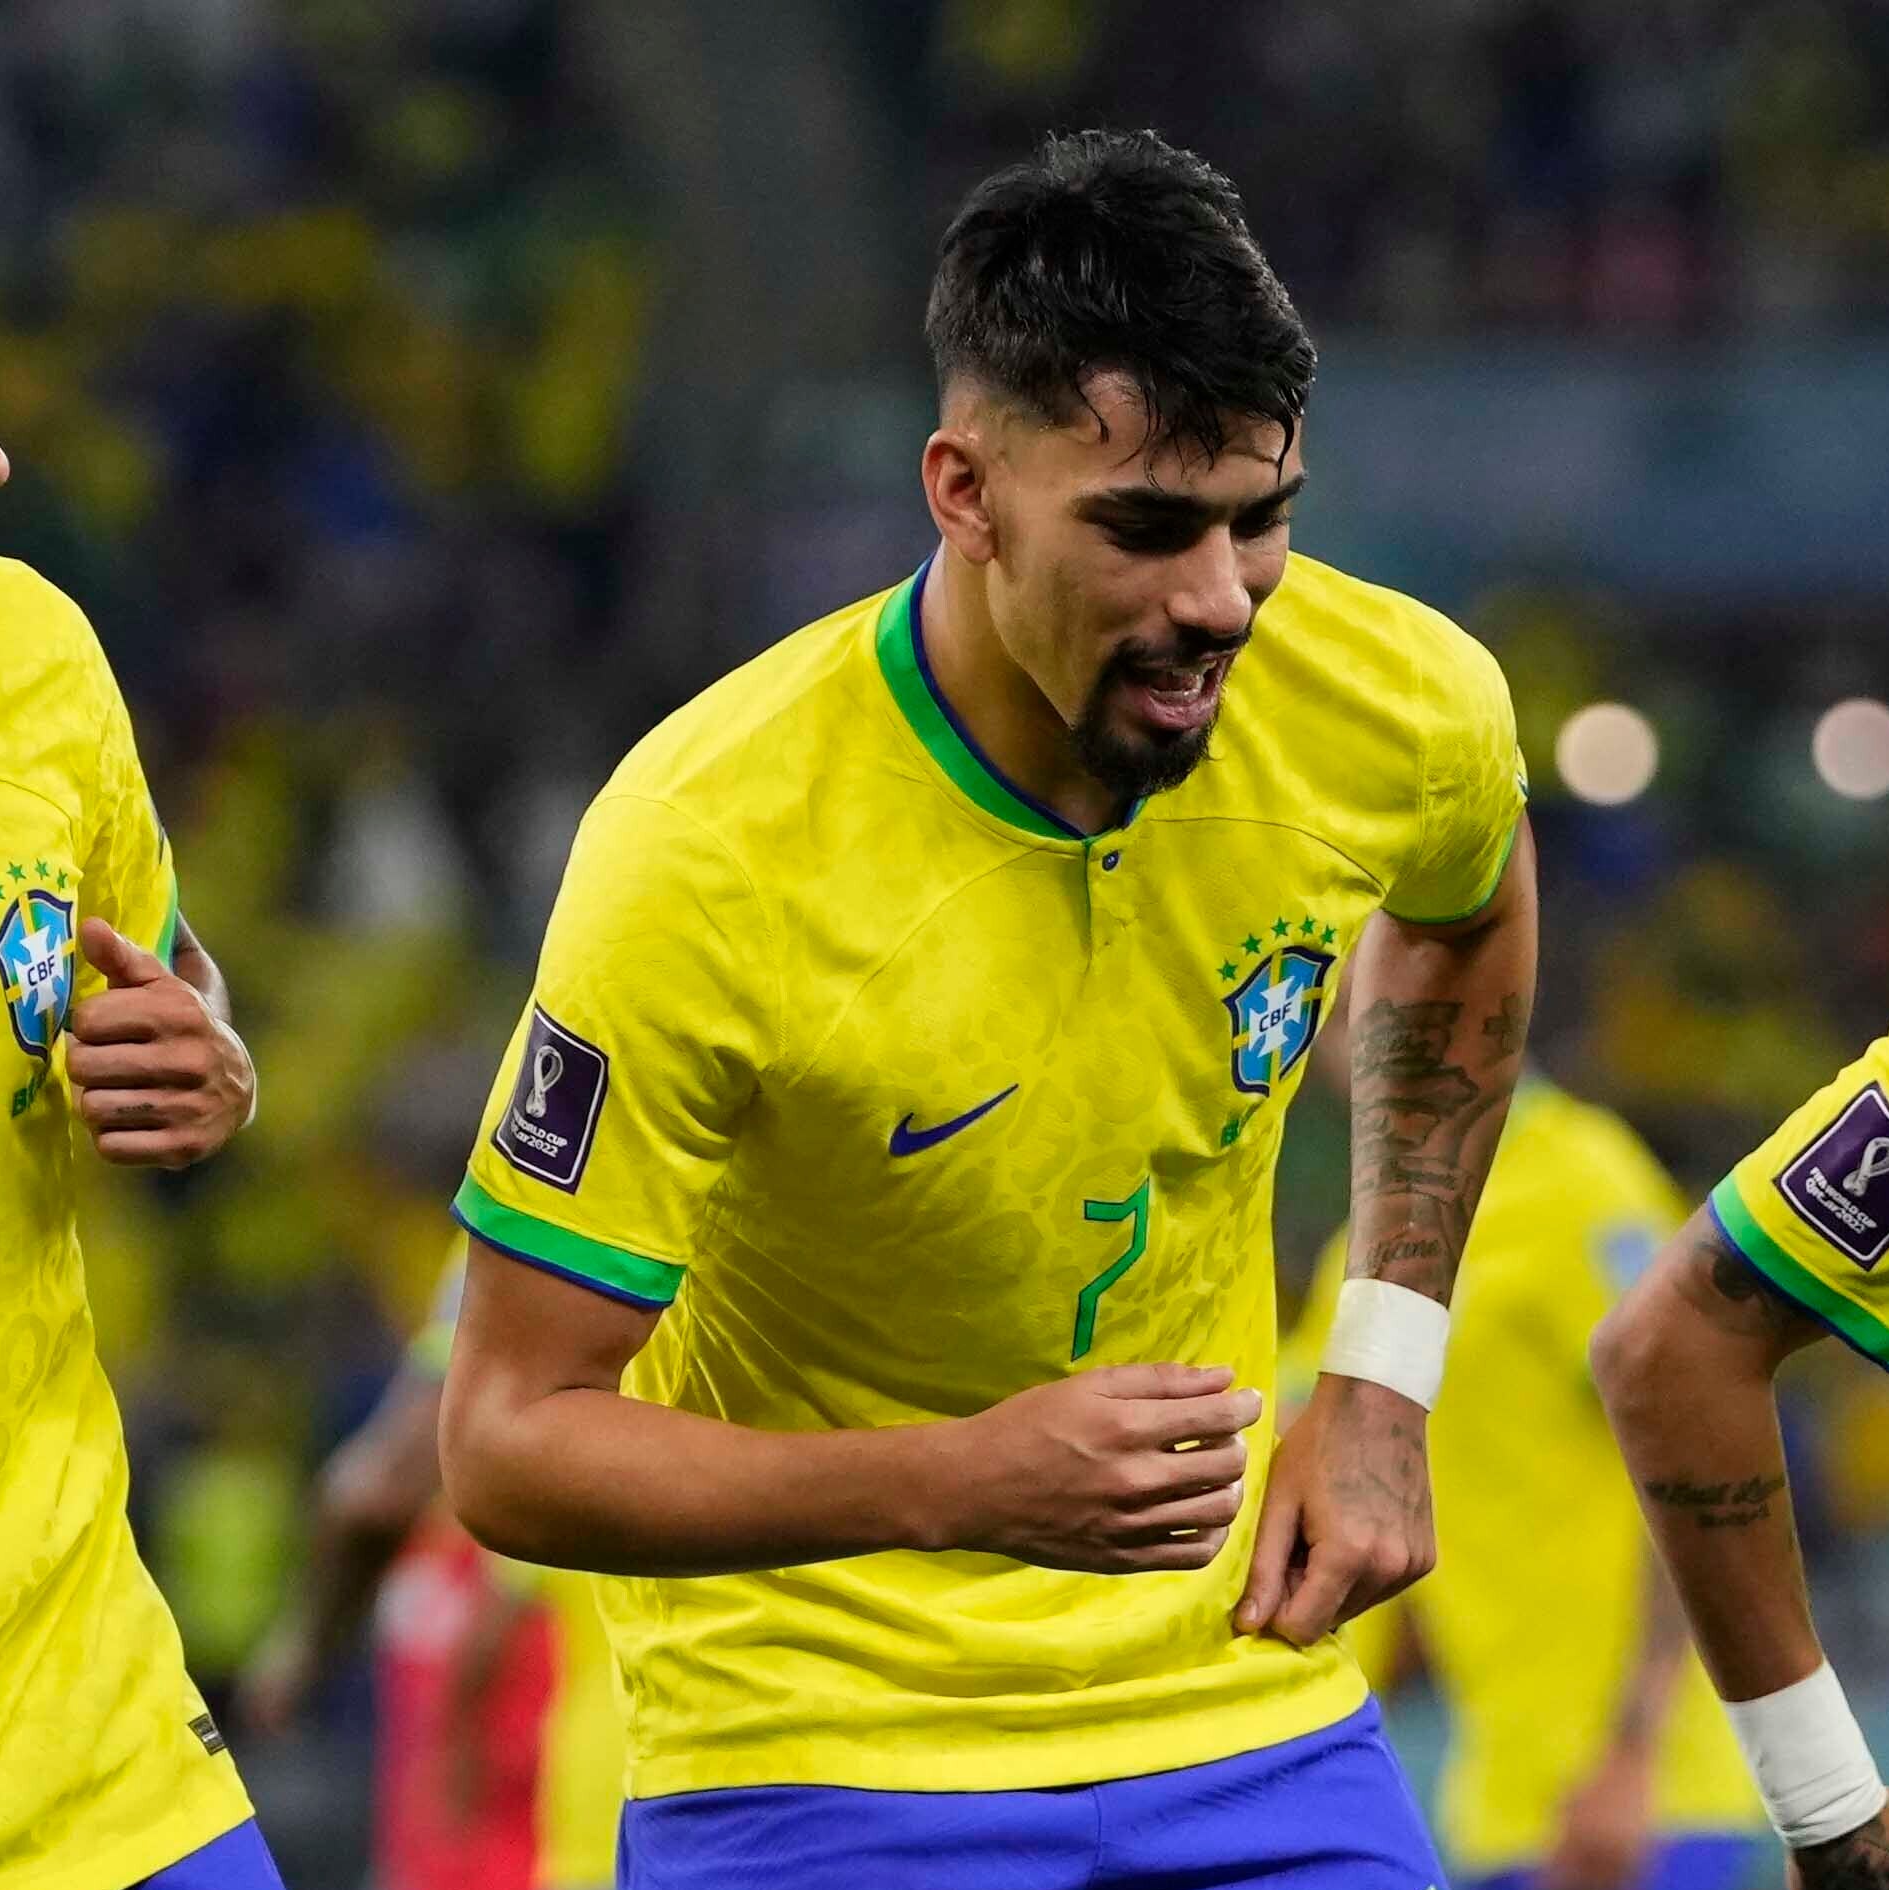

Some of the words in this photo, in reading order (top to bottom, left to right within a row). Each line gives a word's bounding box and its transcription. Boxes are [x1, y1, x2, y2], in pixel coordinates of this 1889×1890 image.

[27, 955, 55, 987] CBF
[1259, 1002, 1293, 1033] CBF
[546, 1132, 568, 1148] CUP
[1824, 1184, 1859, 1214] WORLD
[1856, 1211, 1878, 1229] CUP
[1070, 1176, 1149, 1361] 7
